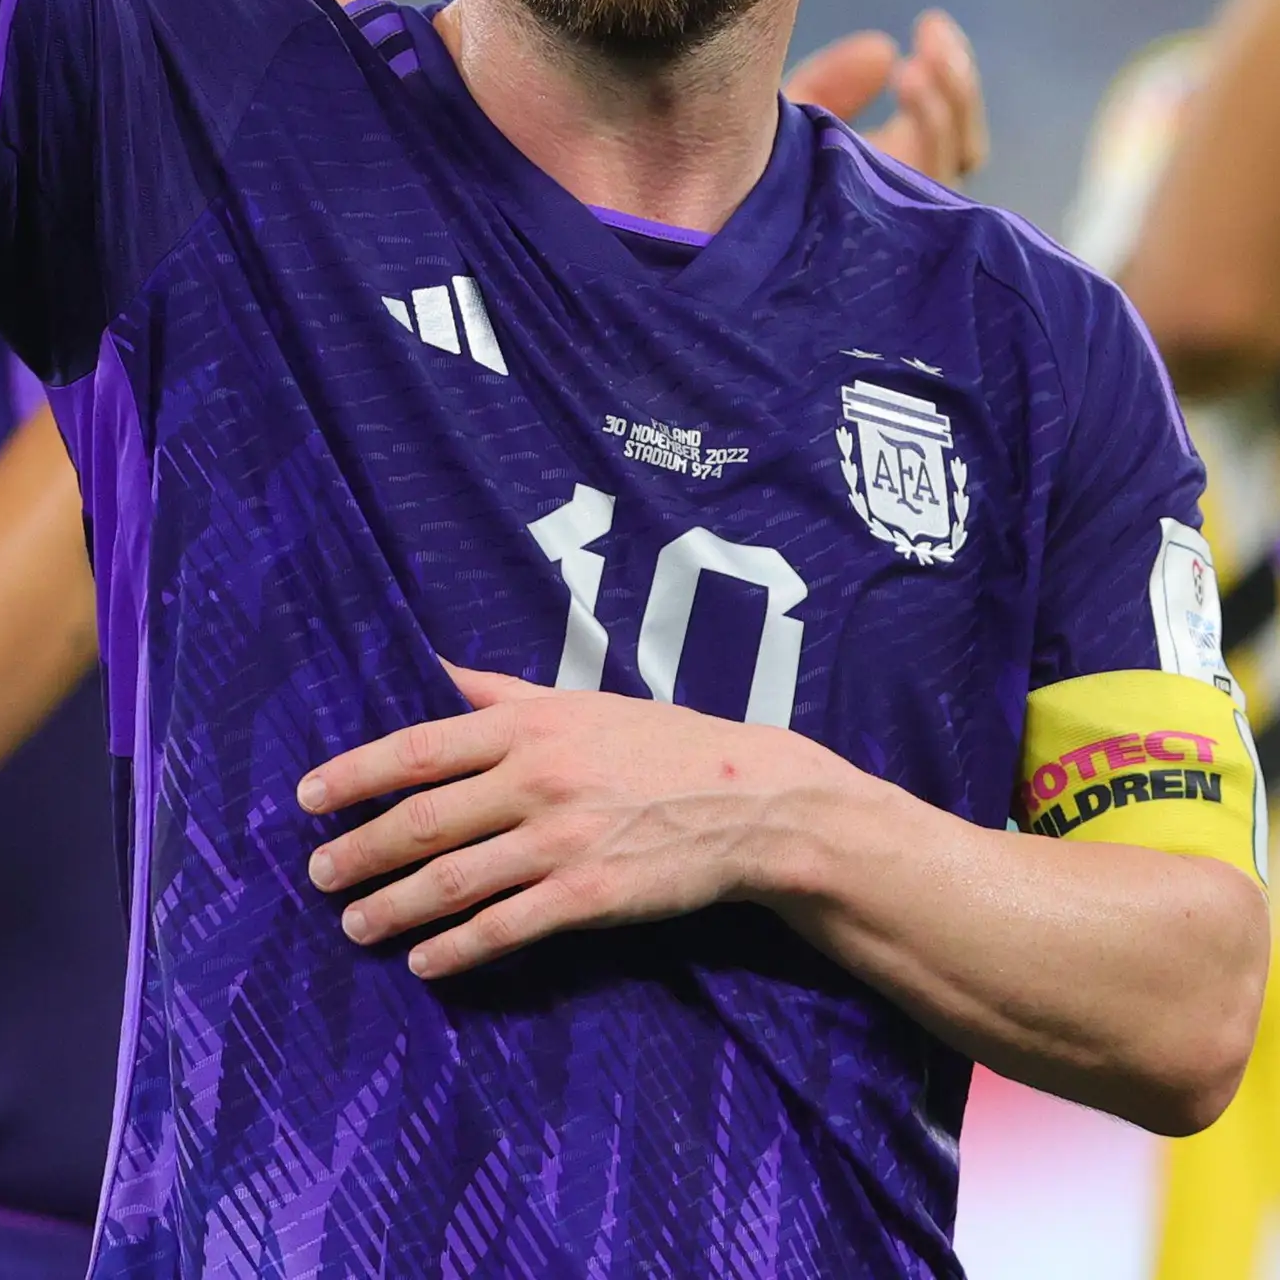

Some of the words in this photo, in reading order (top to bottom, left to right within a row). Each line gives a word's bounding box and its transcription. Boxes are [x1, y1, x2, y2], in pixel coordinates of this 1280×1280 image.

[602, 414, 627, 436] 30
[630, 422, 701, 462] NOVEMBER
[705, 448, 749, 465] 2022
[623, 440, 688, 474] STADIUM
[691, 462, 723, 480] 974
[872, 429, 940, 515] AFA
[526, 482, 809, 730] 10
[1033, 769, 1222, 838] ILDREN
